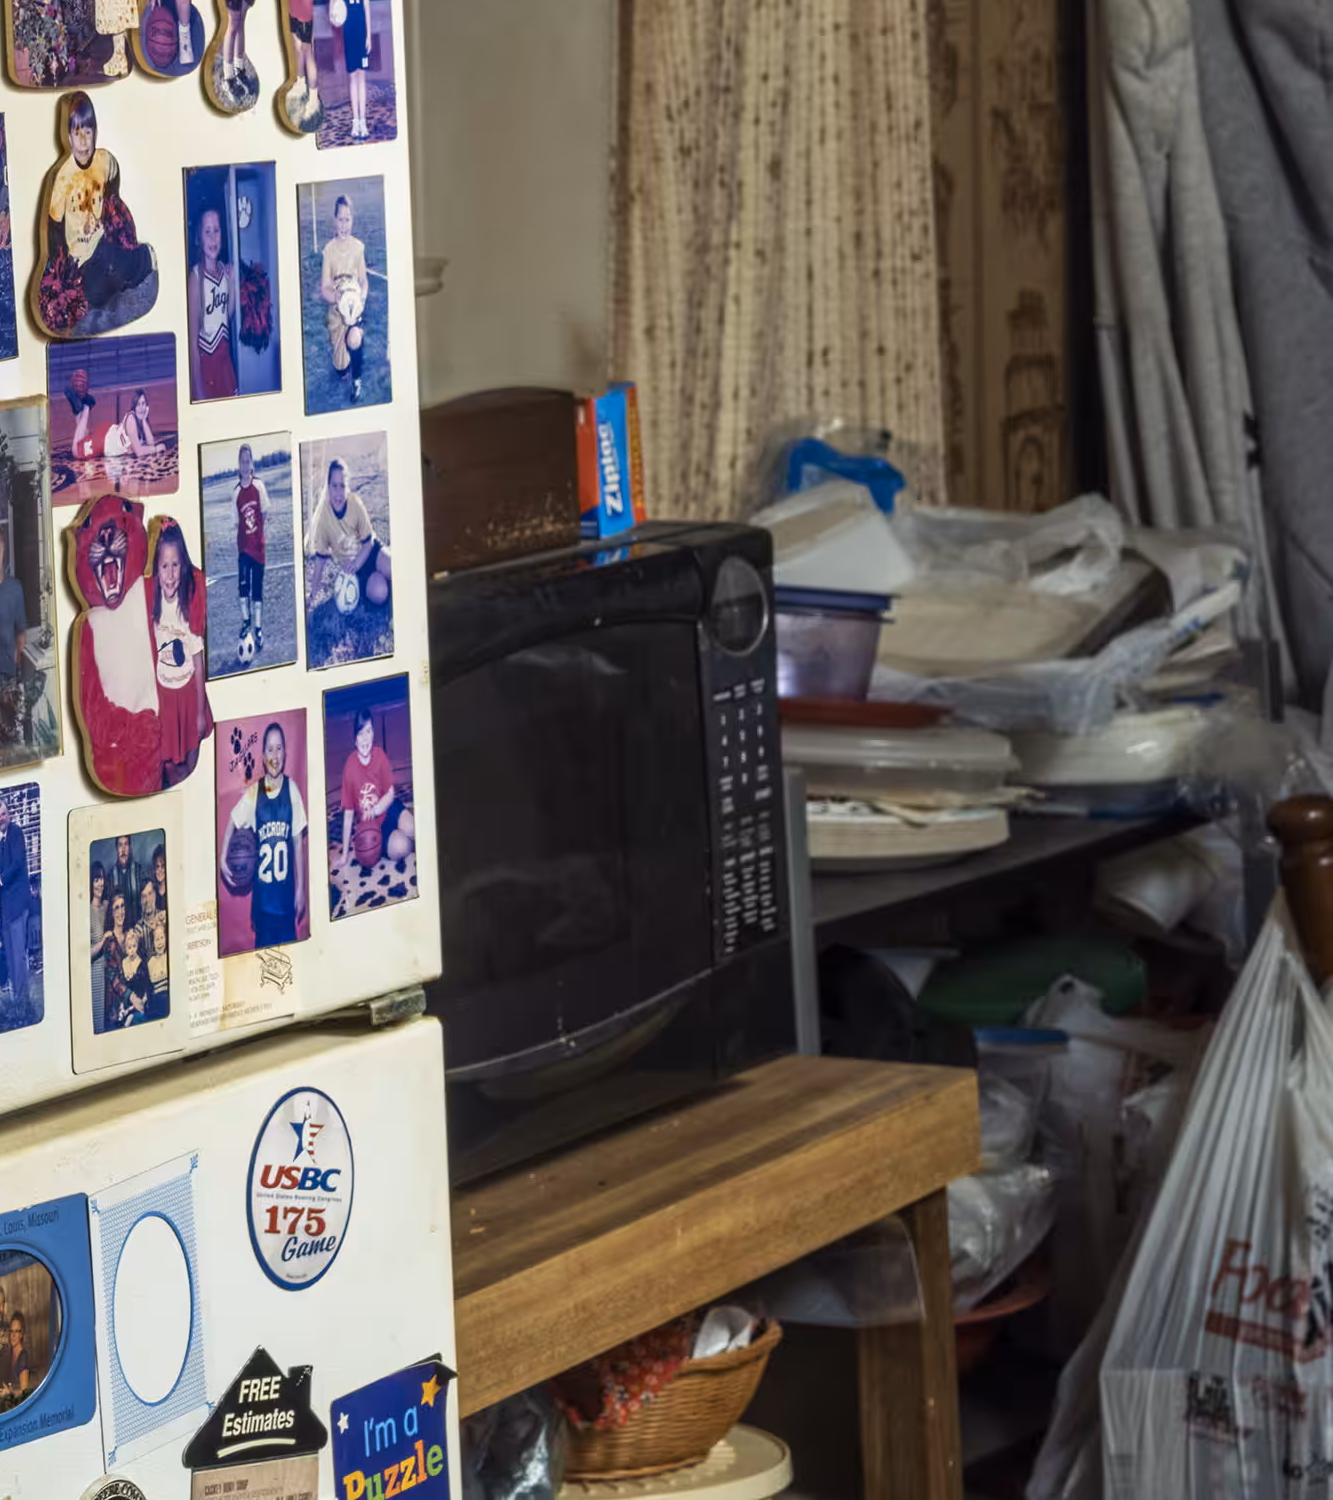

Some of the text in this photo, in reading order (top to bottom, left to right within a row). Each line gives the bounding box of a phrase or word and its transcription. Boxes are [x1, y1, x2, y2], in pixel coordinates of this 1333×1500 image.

[258, 841, 289, 883] 20
[260, 1164, 341, 1192] USBC
[4, 1218, 27, 1235] Louis,
[264, 1205, 326, 1237] 175
[281, 1235, 337, 1262] Game
[239, 1375, 282, 1405] FREE
[0, 1418, 39, 1445] Expansion
[40, 1404, 75, 1429] Memorial
[222, 1409, 294, 1438] Estimates
[363, 1405, 418, 1457] I'm a
[343, 1439, 444, 1500] Puzzle
